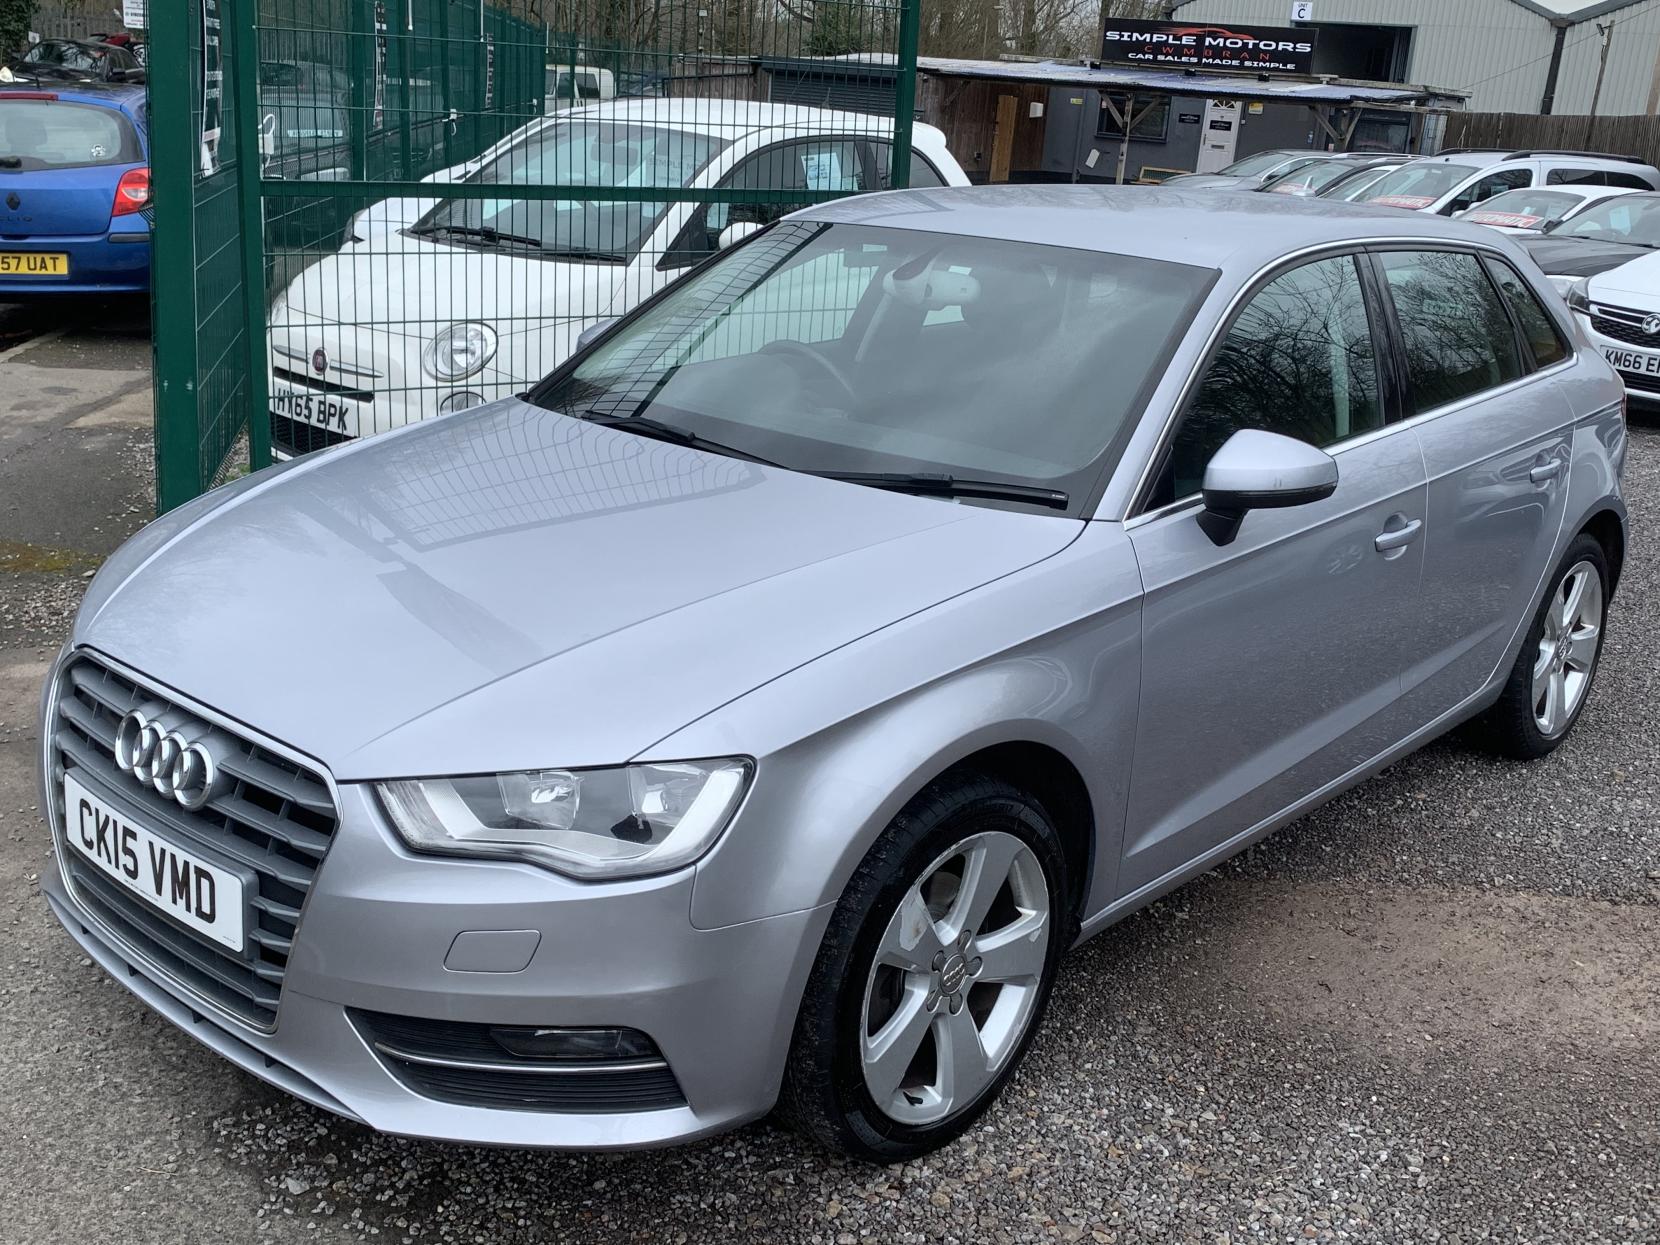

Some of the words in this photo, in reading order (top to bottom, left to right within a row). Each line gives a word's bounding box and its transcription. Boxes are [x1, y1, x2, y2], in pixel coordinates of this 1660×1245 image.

[1297, 8, 1306, 19] C
[1105, 31, 1197, 45] SIMPLE
[1204, 36, 1312, 53] MOTORS
[1128, 52, 1153, 60] CAR
[1156, 54, 1198, 63] SALES
[1202, 58, 1241, 66] MADE
[1244, 61, 1296, 70] SIMPLE
[1144, 45, 1270, 61] CWMBRAN
[27, 256, 59, 272] UAT
[1605, 349, 1643, 370] KM66
[277, 388, 313, 420] HY65
[316, 399, 349, 431] BPK
[79, 798, 139, 881] CK15
[148, 839, 216, 924] VMD
